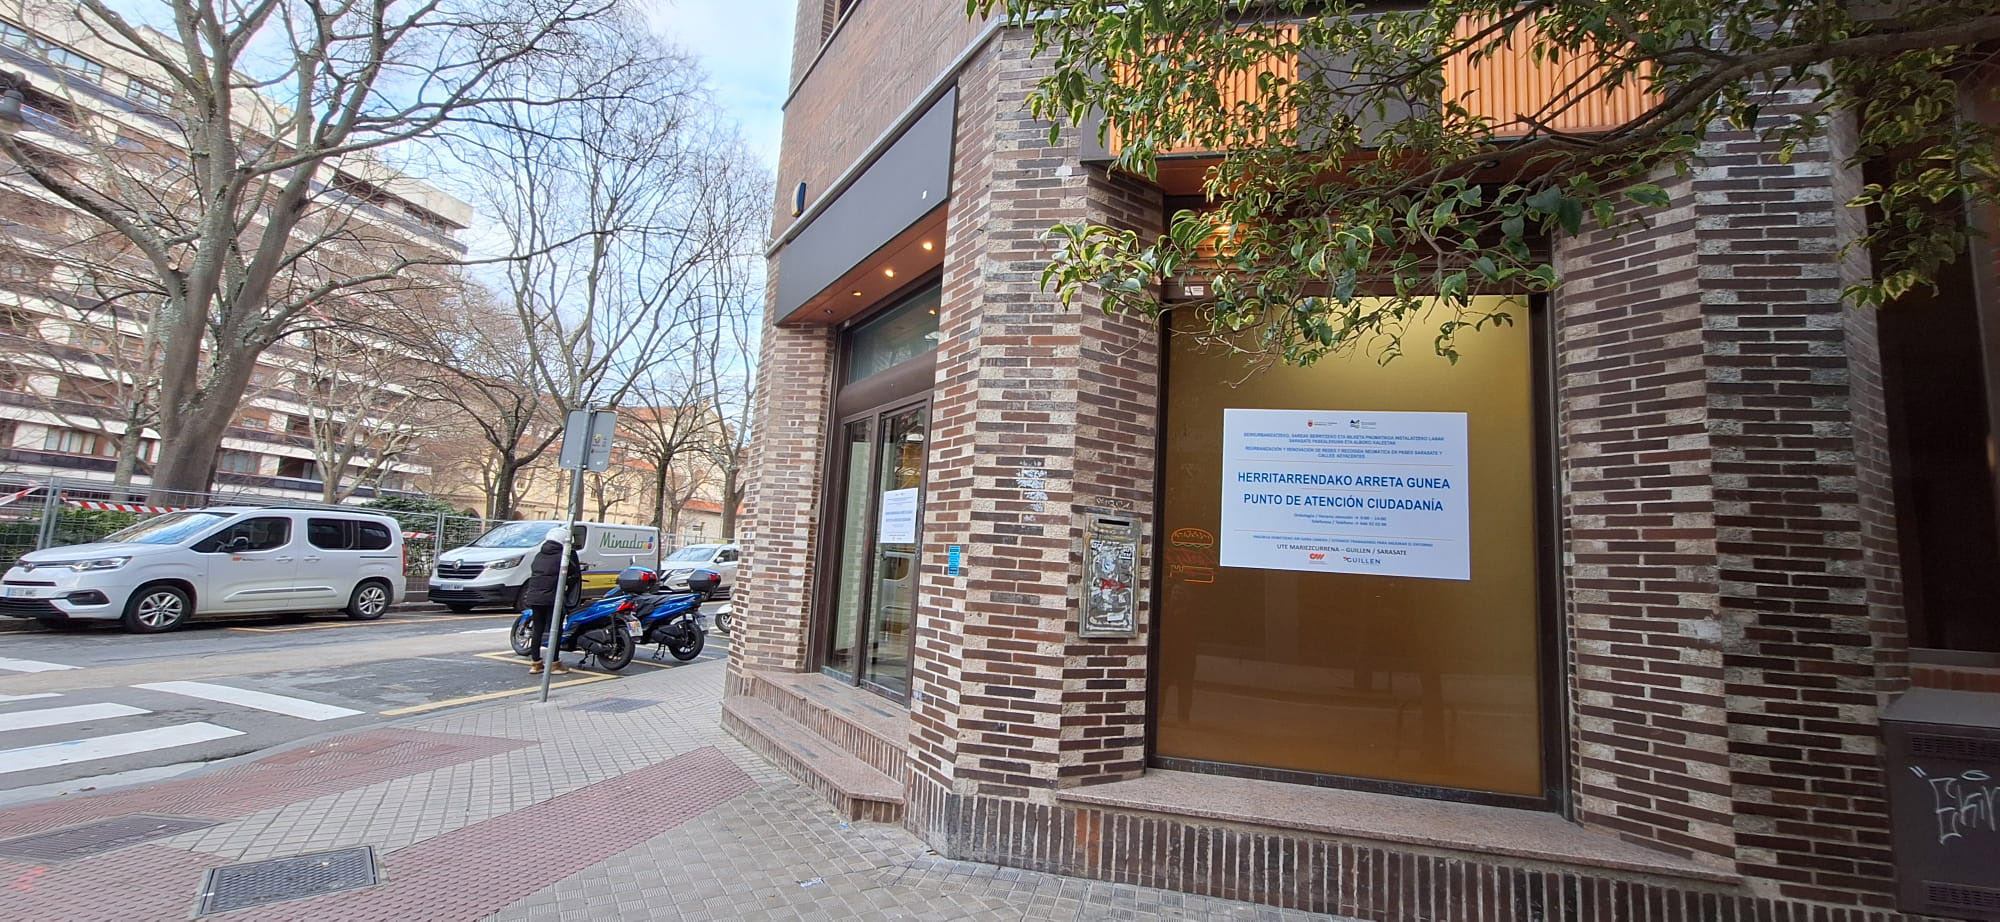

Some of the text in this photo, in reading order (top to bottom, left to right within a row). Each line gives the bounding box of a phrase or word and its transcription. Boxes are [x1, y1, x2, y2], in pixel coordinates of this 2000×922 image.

[1238, 472, 1450, 489] HERRITARRENDAKO ARRETA GUNEA
[1244, 494, 1443, 511] PUNTO DE ATENCIÓN CIUDADANÍA
[600, 532, 642, 549] Minado
